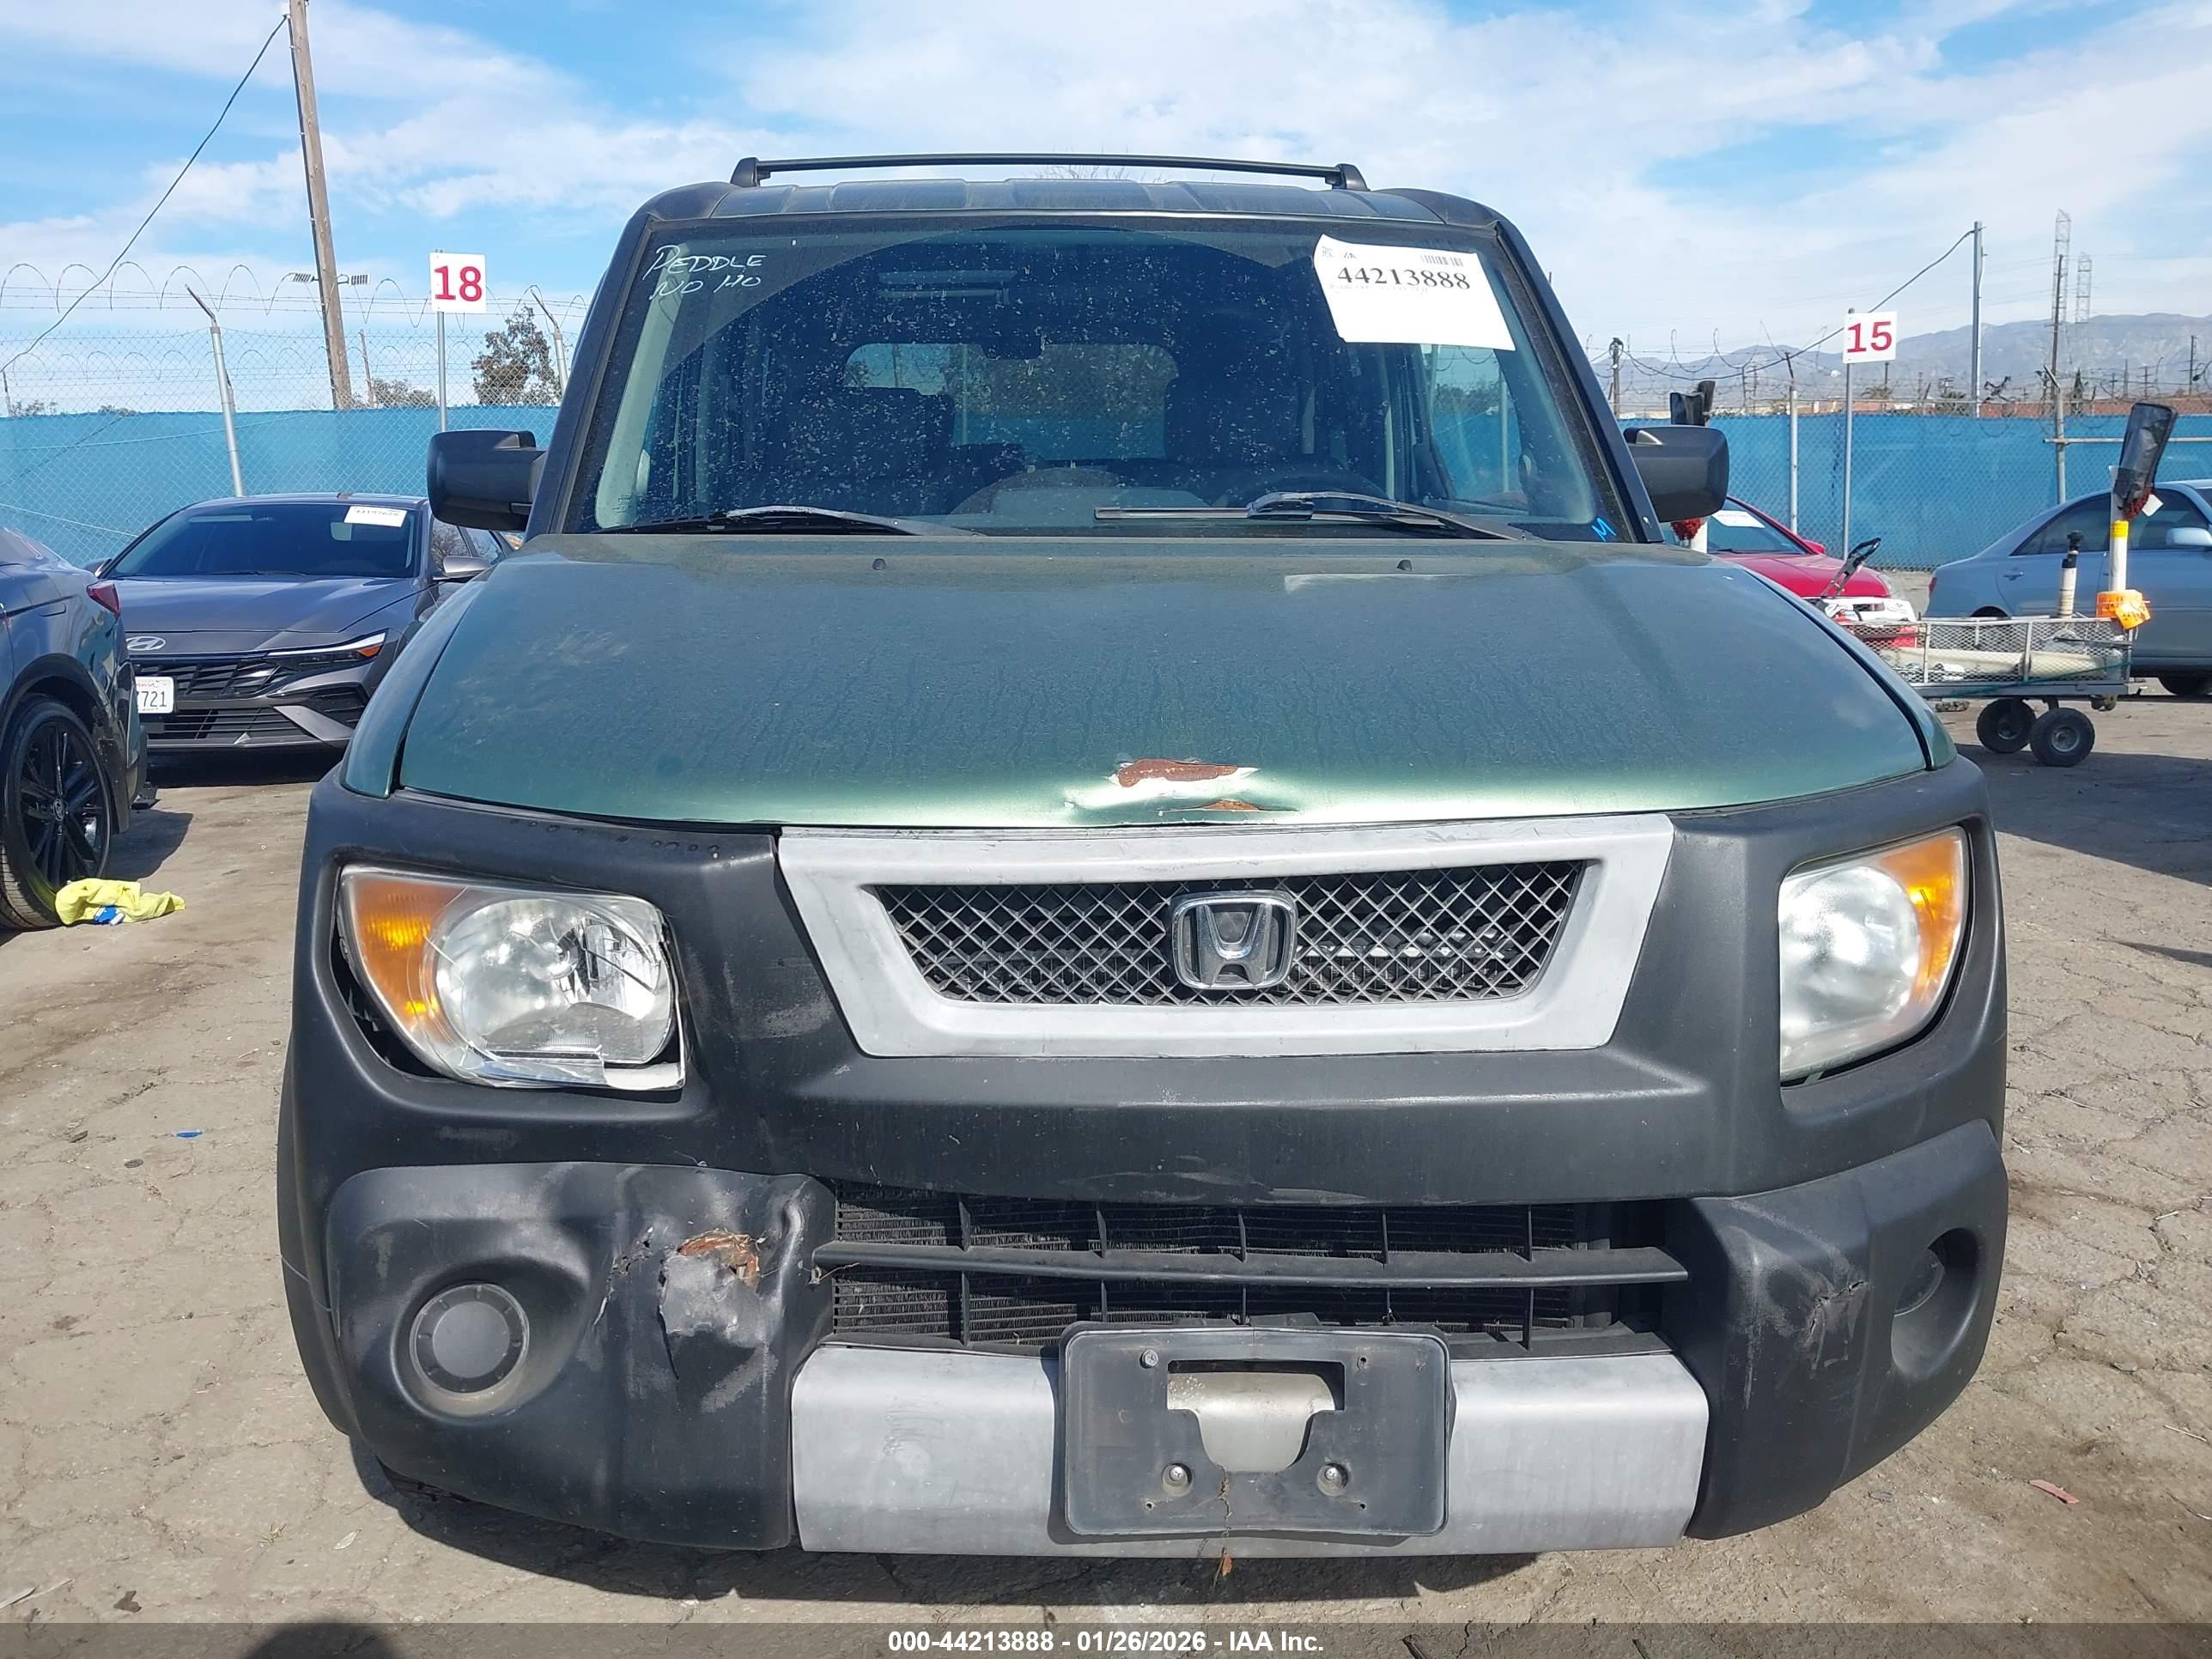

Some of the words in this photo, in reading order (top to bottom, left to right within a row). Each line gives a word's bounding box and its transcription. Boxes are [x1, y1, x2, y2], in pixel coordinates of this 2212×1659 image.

[642, 245, 767, 281] PEDDLE
[1337, 266, 1471, 290] 44213888
[434, 264, 483, 302] 18
[1846, 320, 1893, 354] 15
[137, 690, 167, 708] 721
